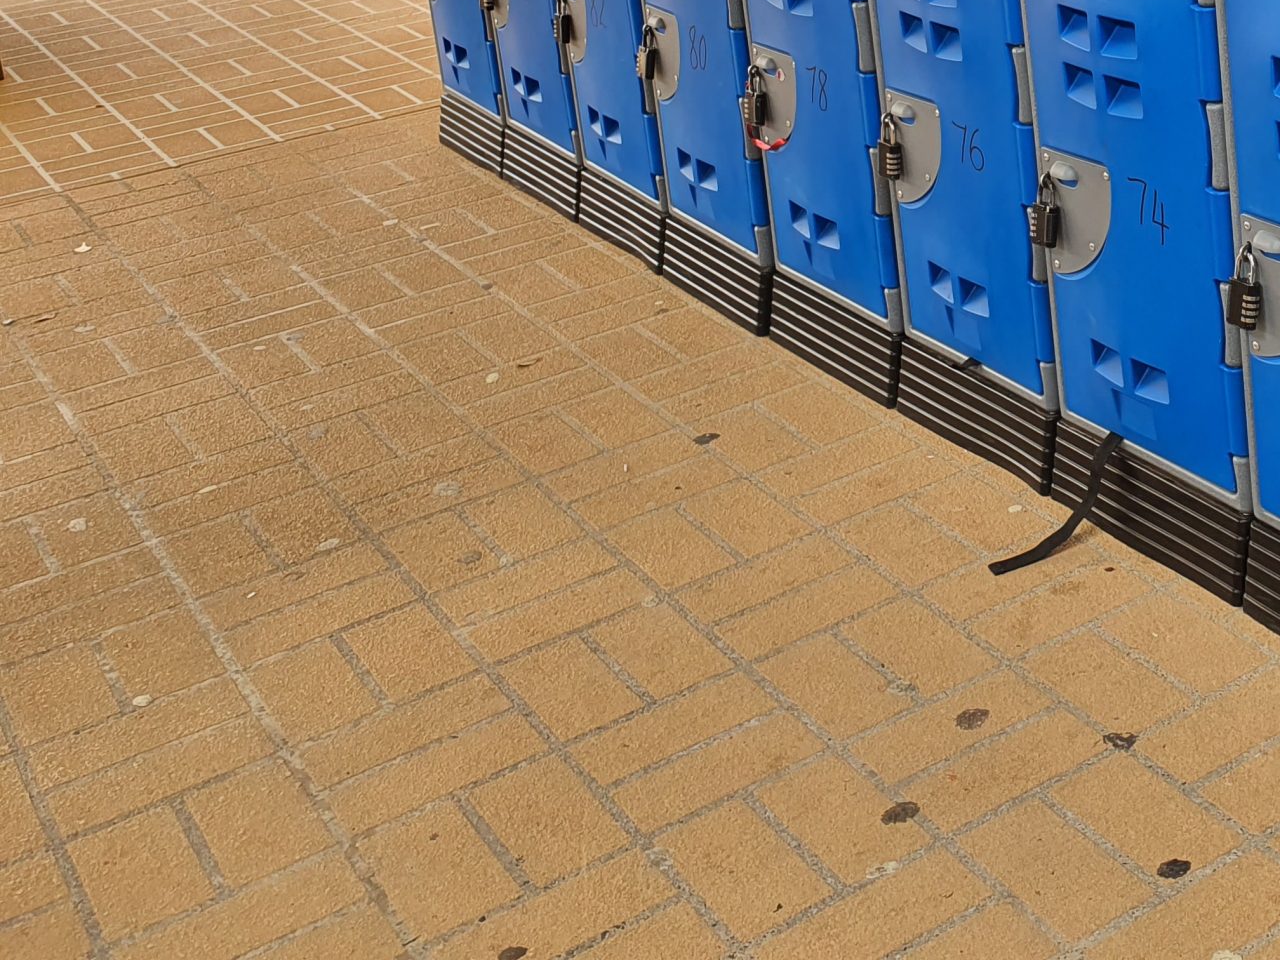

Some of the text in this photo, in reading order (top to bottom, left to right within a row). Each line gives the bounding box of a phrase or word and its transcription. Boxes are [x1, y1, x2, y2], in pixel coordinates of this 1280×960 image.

[688, 24, 708, 71] 80
[805, 65, 828, 113] 78
[951, 120, 985, 172] 76
[1127, 176, 1171, 247] 74
